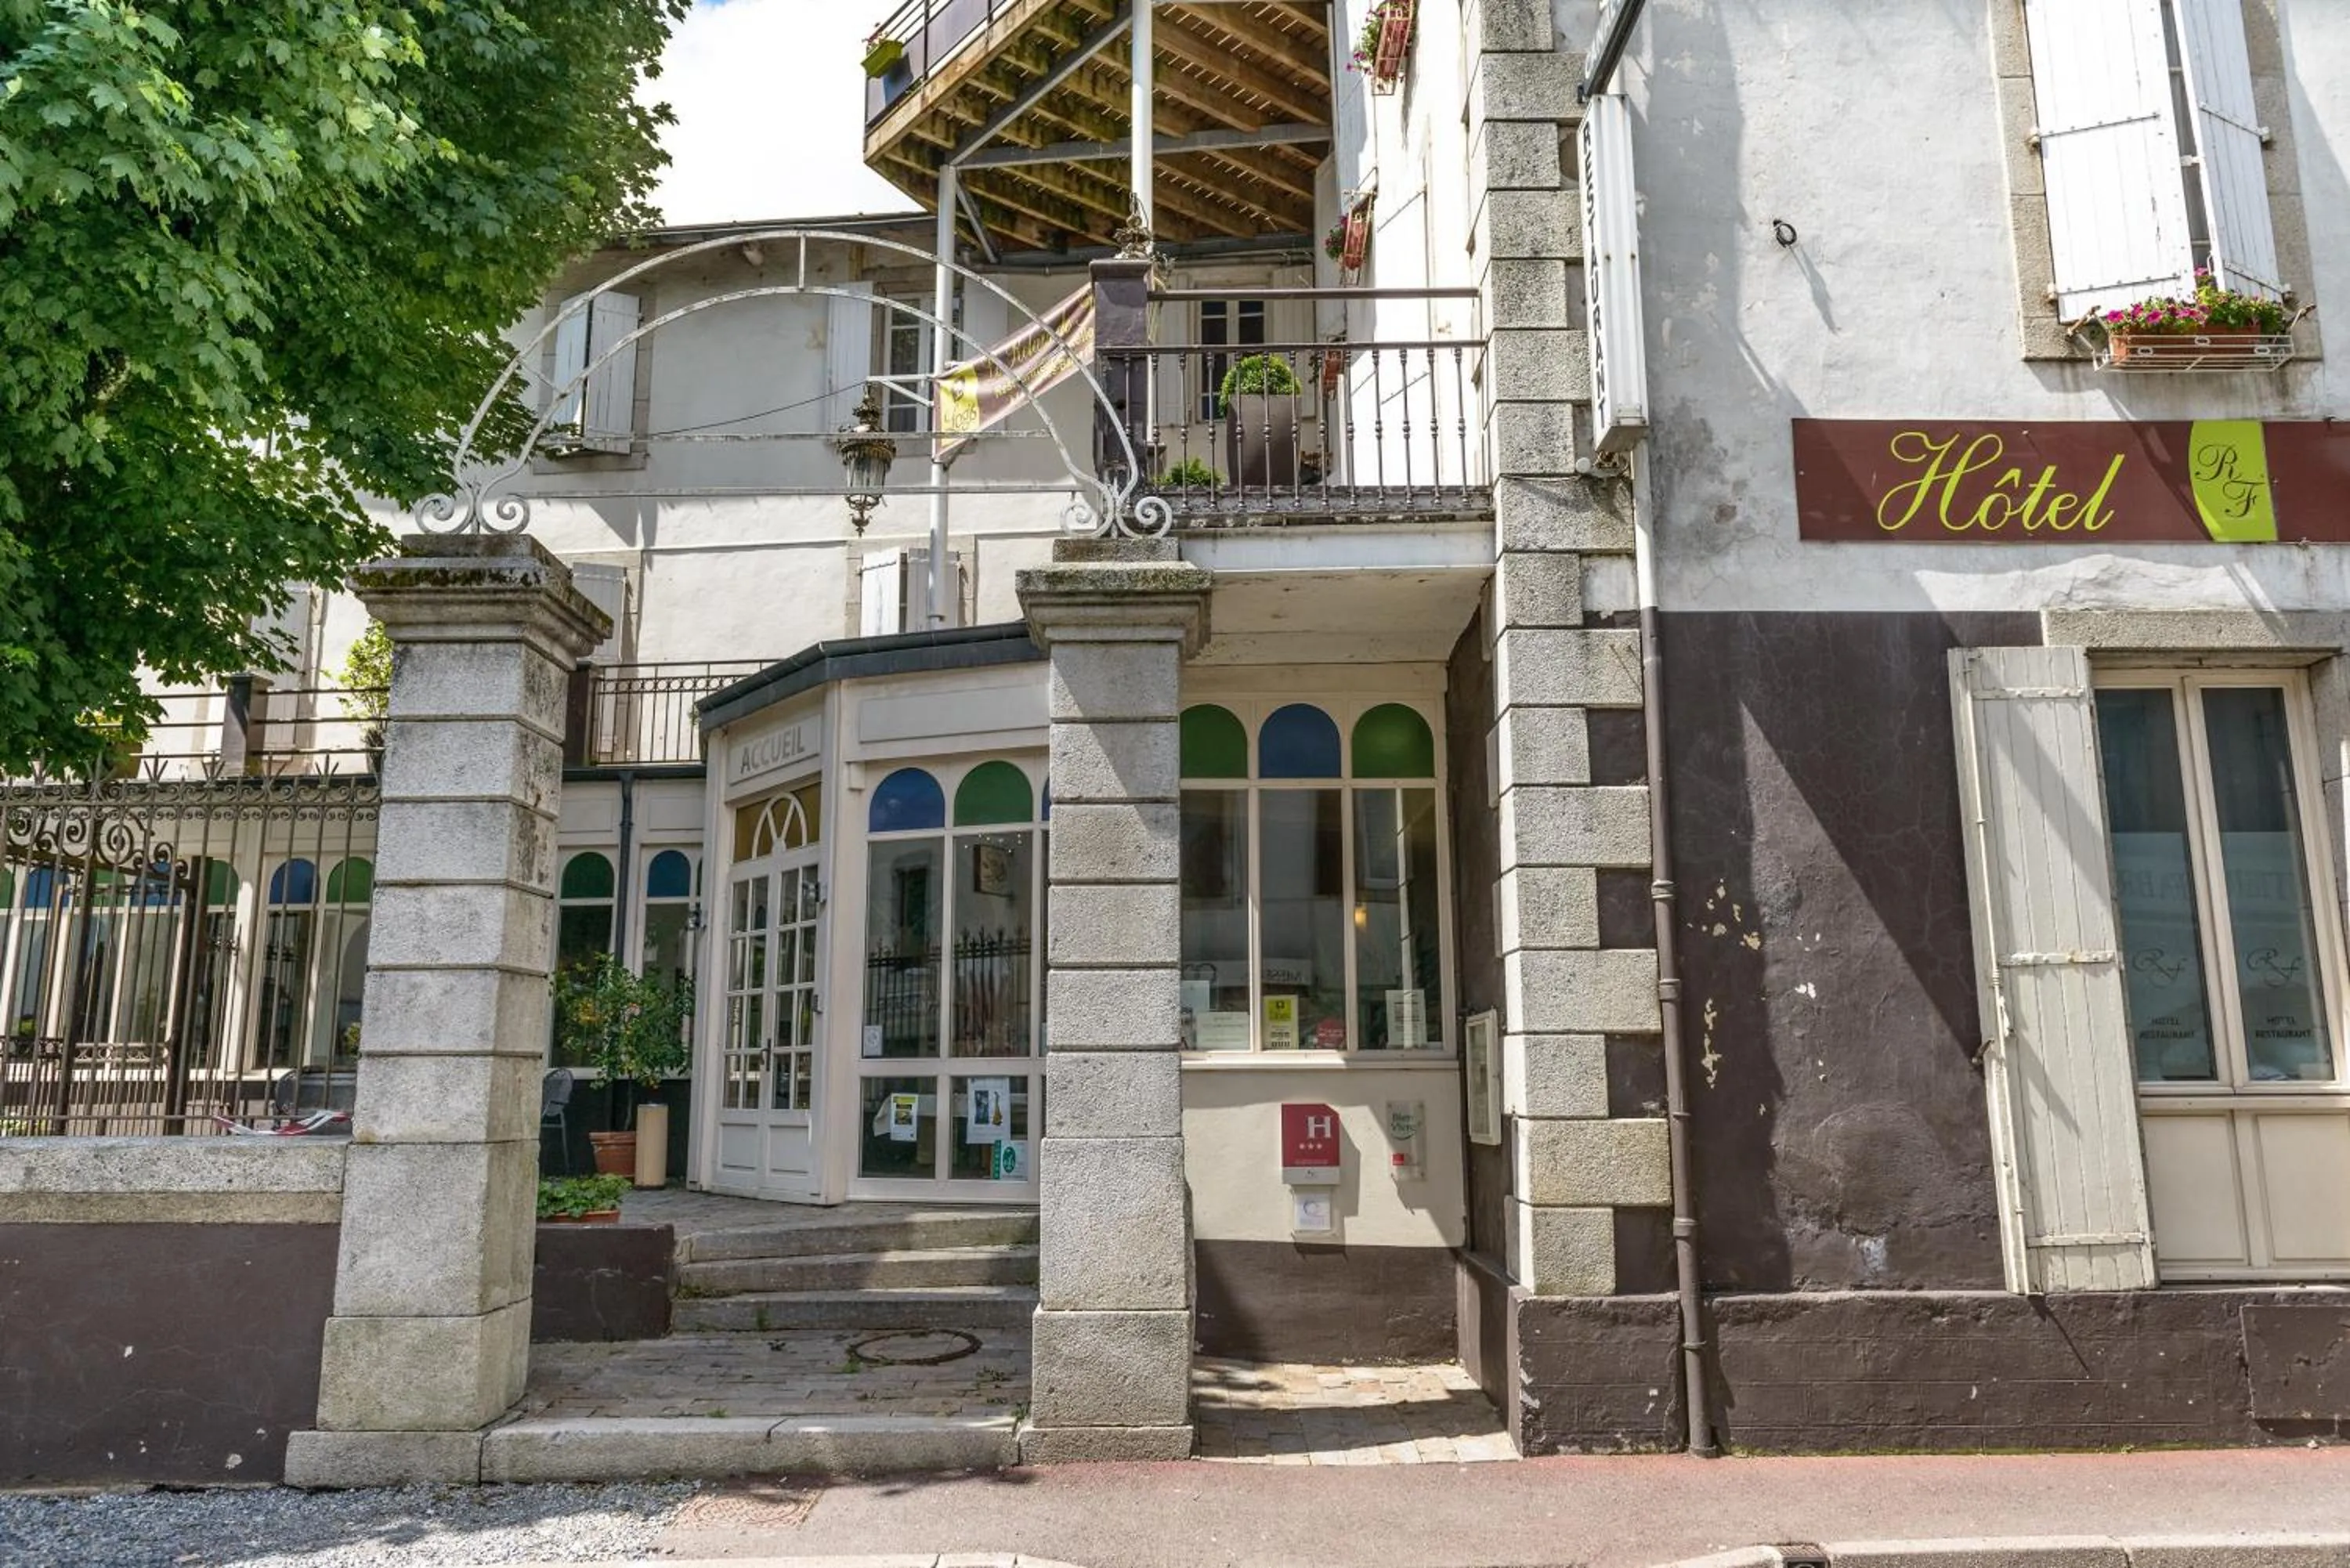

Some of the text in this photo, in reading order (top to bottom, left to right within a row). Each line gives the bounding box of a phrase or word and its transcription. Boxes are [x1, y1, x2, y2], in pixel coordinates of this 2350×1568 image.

[1583, 121, 1606, 428] RESTAURANT
[1878, 432, 2125, 530] Hôtel
[740, 725, 805, 774] ACCUEIL
[2139, 1030, 2194, 1039] RESTAURANT
[2255, 1029, 2311, 1039] RESTAURANT
[1307, 1115, 1332, 1139] H
